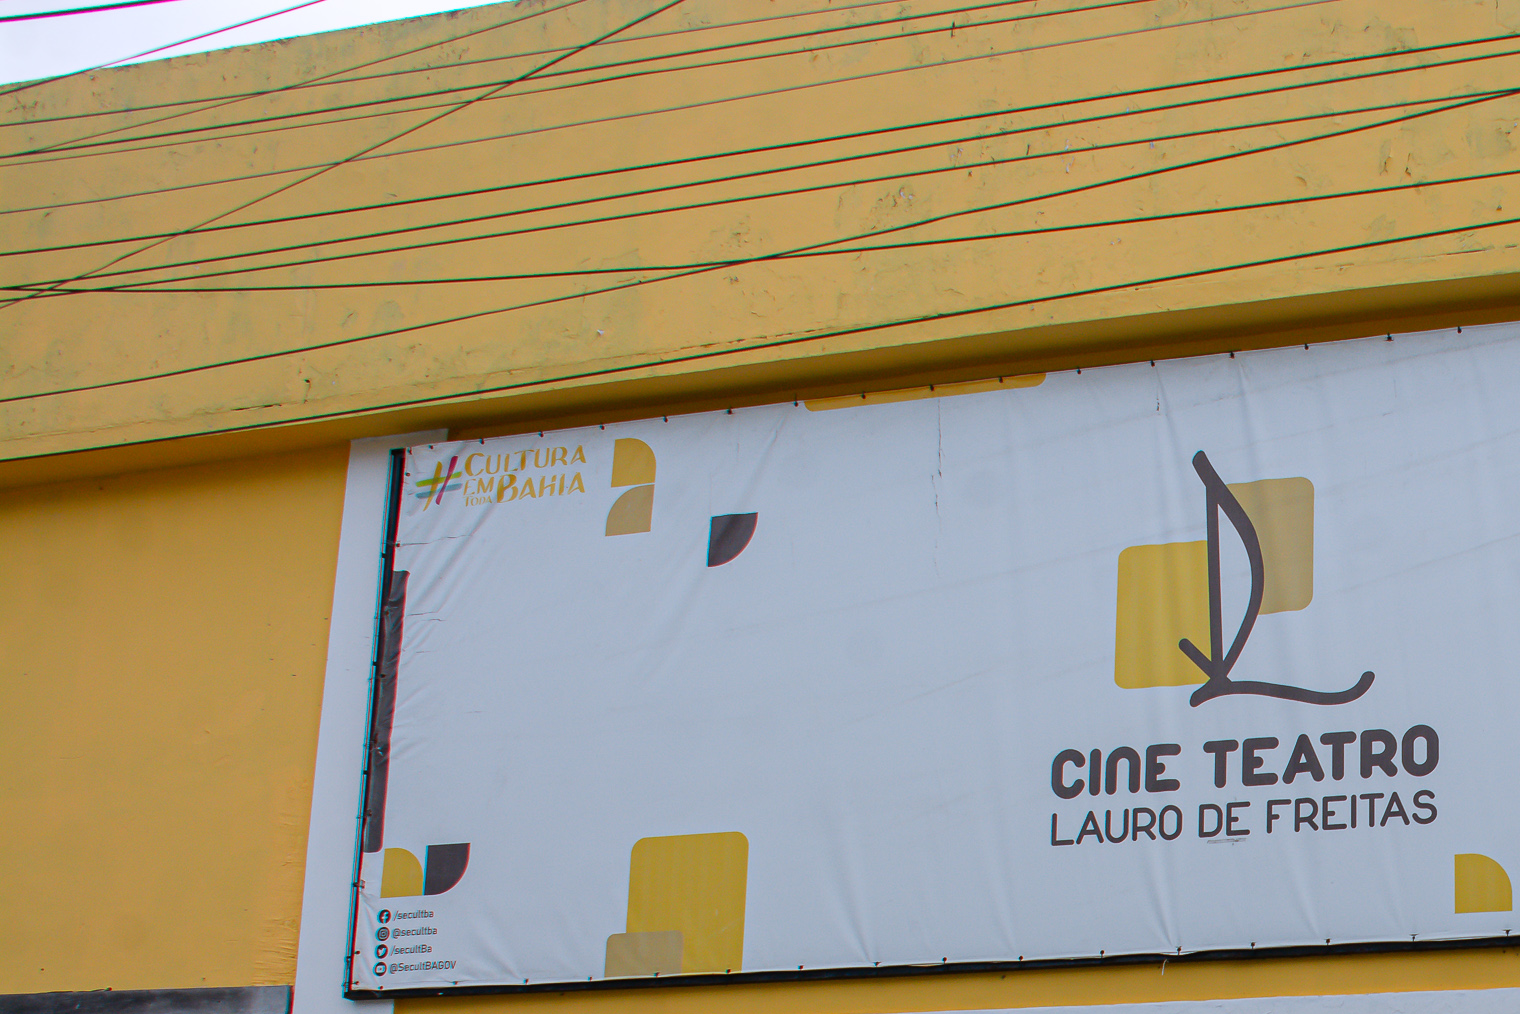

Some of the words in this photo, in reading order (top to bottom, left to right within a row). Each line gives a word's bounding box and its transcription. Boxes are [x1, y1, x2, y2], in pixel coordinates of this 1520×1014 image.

[463, 477, 494, 496] EM
[496, 472, 586, 504] BAHIA
[464, 495, 492, 507] TODA
[1203, 724, 1440, 789] TEATRO
[1051, 804, 1183, 846] LAURO
[1198, 800, 1251, 838] DE
[1266, 789, 1438, 834] FREITAS
[393, 927, 438, 939] @secultba
